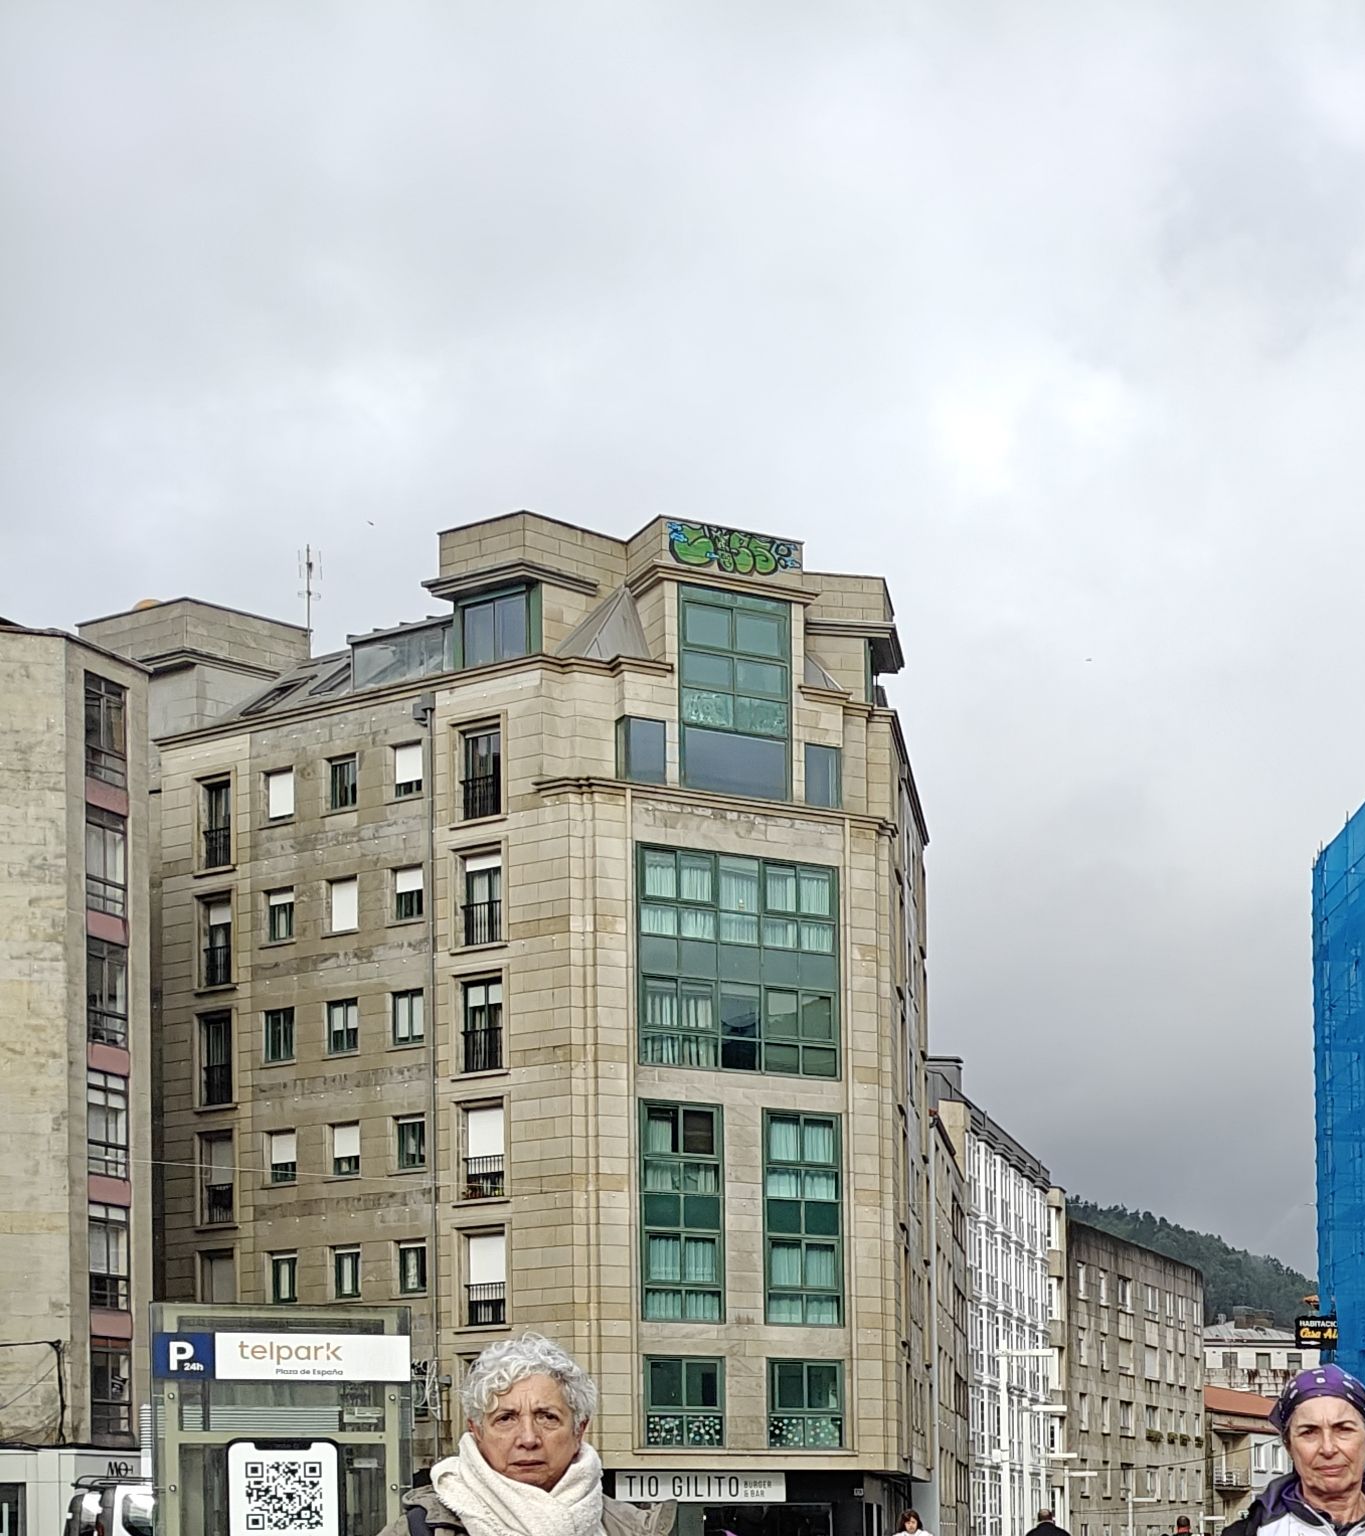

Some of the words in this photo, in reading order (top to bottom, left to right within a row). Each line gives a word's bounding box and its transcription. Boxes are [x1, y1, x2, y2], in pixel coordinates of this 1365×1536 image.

[1300, 1327, 1321, 1339] Casa
[168, 1341, 195, 1371] P
[238, 1340, 343, 1366] telpark
[184, 1362, 204, 1372] 24h
[275, 1368, 299, 1376] Plaza
[300, 1368, 311, 1376] de
[312, 1368, 344, 1378] España
[625, 1475, 659, 1498] TIO
[672, 1475, 740, 1498] GILITO
[743, 1480, 773, 1489] BURGER
[750, 1489, 765, 1498] BAR
